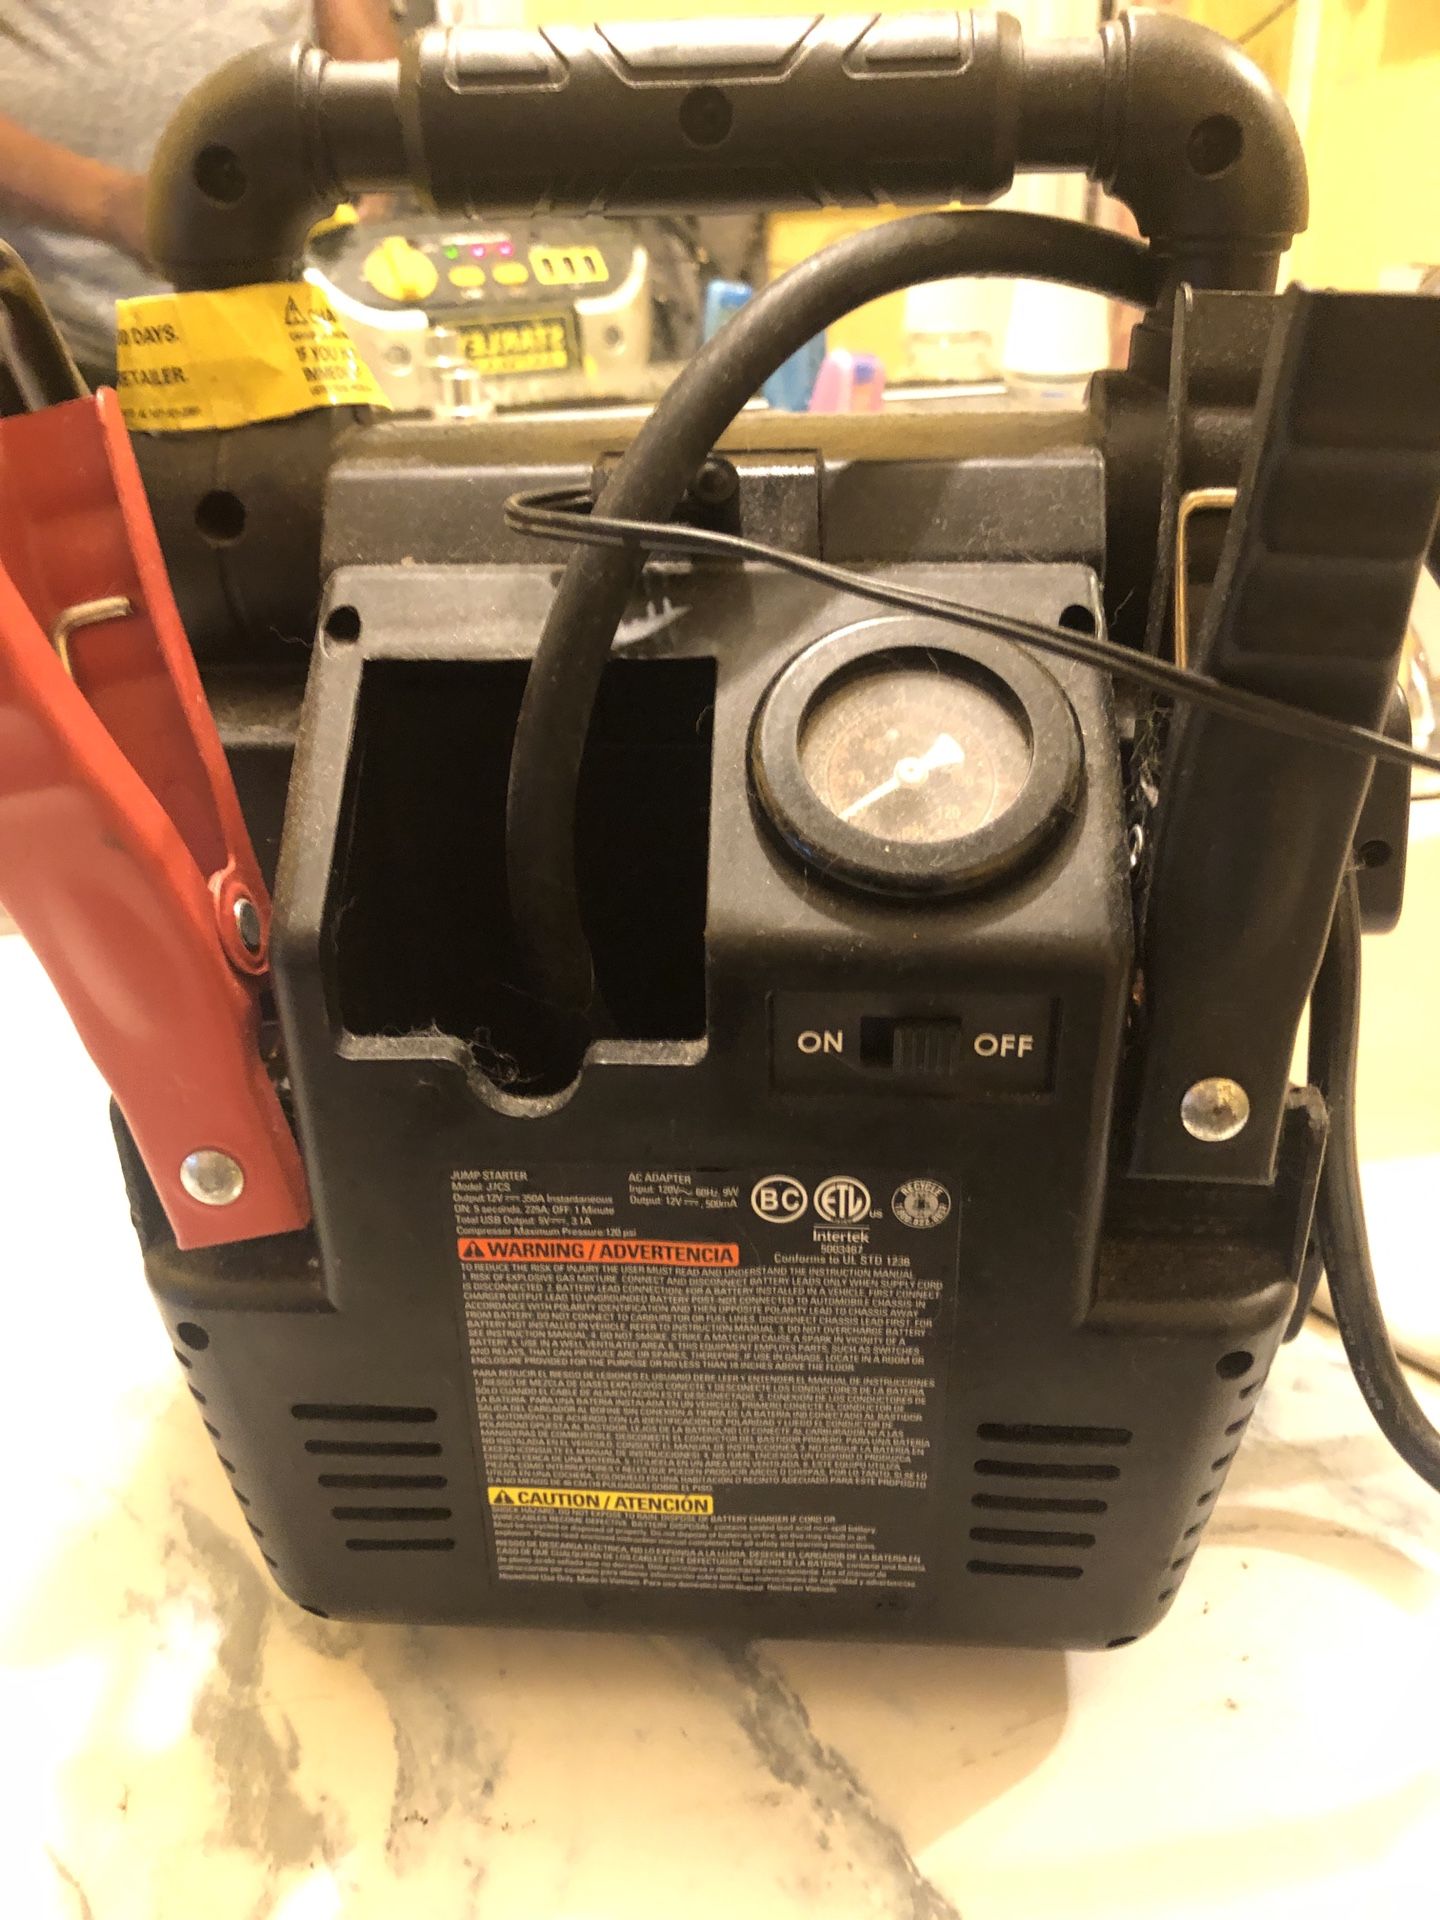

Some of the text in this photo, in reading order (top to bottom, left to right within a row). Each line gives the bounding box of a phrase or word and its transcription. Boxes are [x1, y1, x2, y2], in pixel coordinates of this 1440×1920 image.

[798, 1029, 843, 1053] ON
[974, 1033, 1033, 1058] OFF
[450, 1171, 528, 1181] JUMP STARTER
[628, 1172, 691, 1185] AC ADAPTER
[900, 1180, 943, 1197] RECYCLE
[547, 1194, 613, 1204] Instantaneous
[666, 1196, 682, 1206] 12V
[760, 1187, 800, 1211] BC
[581, 1206, 615, 1215] Minute
[455, 1215, 479, 1224] Total
[480, 1215, 501, 1225] USB
[456, 1226, 512, 1237] Compressor
[513, 1227, 560, 1237] Maximum
[622, 1229, 636, 1239] psi
[813, 1228, 870, 1244] Intertek
[487, 1241, 584, 1259] WARNING
[600, 1243, 734, 1263] ADVERTENCIA
[774, 1253, 826, 1265] Conforms
[829, 1255, 840, 1265] to
[842, 1255, 857, 1265] UL
[859, 1255, 882, 1266] STD
[474, 1264, 510, 1273] REDUCE
[530, 1265, 552, 1274] RISK
[621, 1266, 645, 1275] USER
[647, 1267, 673, 1277] MUST
[675, 1269, 699, 1278] READ
[723, 1268, 788, 1278] UNDERSTAND
[808, 1269, 871, 1279] INSTRUCTION
[470, 1273, 491, 1282] RISK
[506, 1273, 553, 1284] EXPLOSIVE
[622, 1275, 664, 1285] CONNECT
[688, 1278, 747, 1288] DISCONNECT
[749, 1277, 789, 1287] BATTERY
[791, 1278, 821, 1287] LEADS
[823, 1278, 847, 1288] ONLY
[848, 1279, 880, 1289] WHEN
[881, 1280, 915, 1290] SUPPLY
[917, 1279, 943, 1291] CORD
[463, 1292, 507, 1302] CHARGER
[508, 1293, 543, 1302] OUTPUT
[545, 1294, 568, 1303] LEAD
[583, 1294, 648, 1304] UNGROUNDED
[649, 1296, 690, 1305] BATTERY
[739, 1297, 795, 1306] CONNECTED
[810, 1298, 870, 1308] AUTOMOBILE
[872, 1299, 912, 1309] CHASSIS
[555, 1284, 595, 1293] BATTERY
[598, 1285, 620, 1294] LEAD
[713, 1288, 753, 1297] BATTERY
[756, 1287, 806, 1297] INSTALLED
[868, 1289, 894, 1299] FIRST
[895, 1290, 939, 1301] CONNECT
[464, 1302, 525, 1311] ACCORDANCE
[527, 1303, 552, 1312] WITH
[554, 1303, 596, 1312] POLARITY
[598, 1304, 669, 1314] IDENTIFICATION
[692, 1305, 717, 1315] THEN
[719, 1306, 763, 1315] OPPOSITE
[765, 1306, 807, 1316] POLARITY
[808, 1307, 833, 1317] LEAD
[848, 1308, 888, 1318] CHASSIS
[890, 1310, 919, 1318] AWAY
[465, 1311, 492, 1320] FROM
[572, 1313, 614, 1322] CONNECT
[630, 1314, 690, 1323] CARBURETOR
[706, 1315, 727, 1324] FUEL
[759, 1316, 817, 1326] DISCONNECT
[818, 1317, 858, 1327] CHASSIS
[860, 1318, 884, 1328] LEAD
[518, 1491, 600, 1508] CAUTION
[615, 1494, 708, 1513] ATENCIÓN
